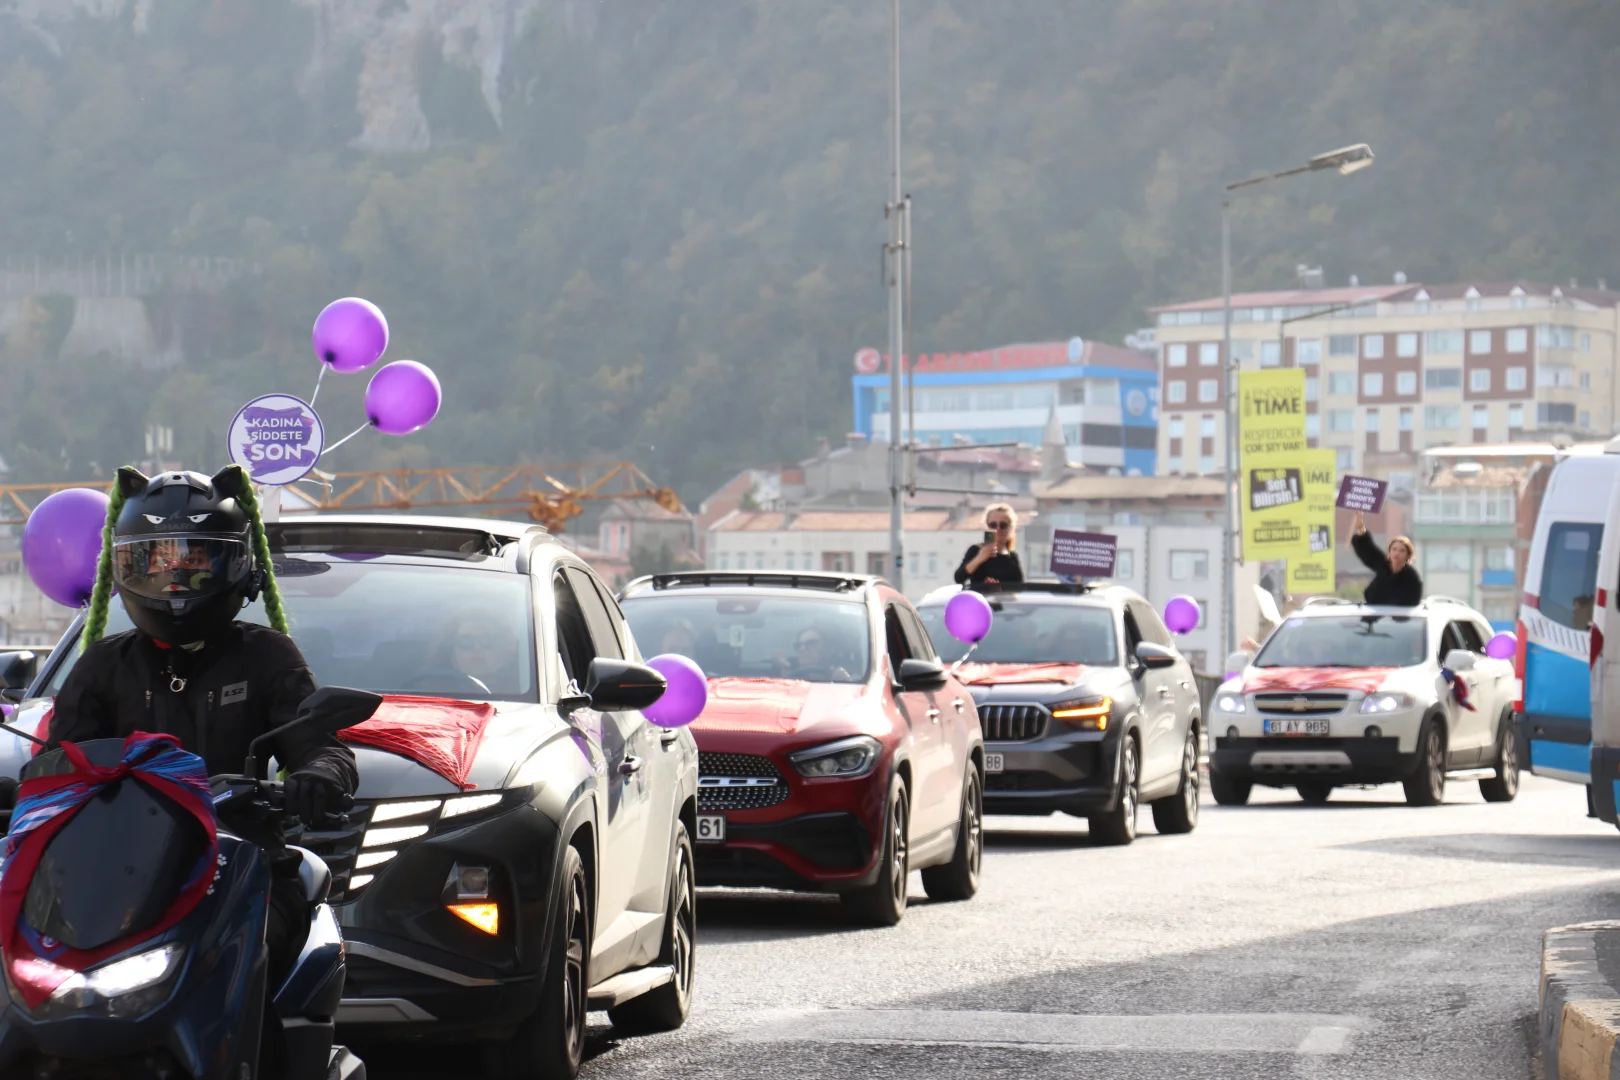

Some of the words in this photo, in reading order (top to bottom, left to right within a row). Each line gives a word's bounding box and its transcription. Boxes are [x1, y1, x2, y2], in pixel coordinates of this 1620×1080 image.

[1254, 398, 1300, 415] TIME
[252, 418, 302, 427] KADINA
[251, 430, 302, 442] ŞİDDETE
[250, 443, 301, 460] SON
[224, 688, 244, 697] LS2
[1270, 721, 1281, 732] 61
[1286, 721, 1299, 732] AY
[1306, 721, 1328, 732] 965
[699, 818, 720, 837] 61
